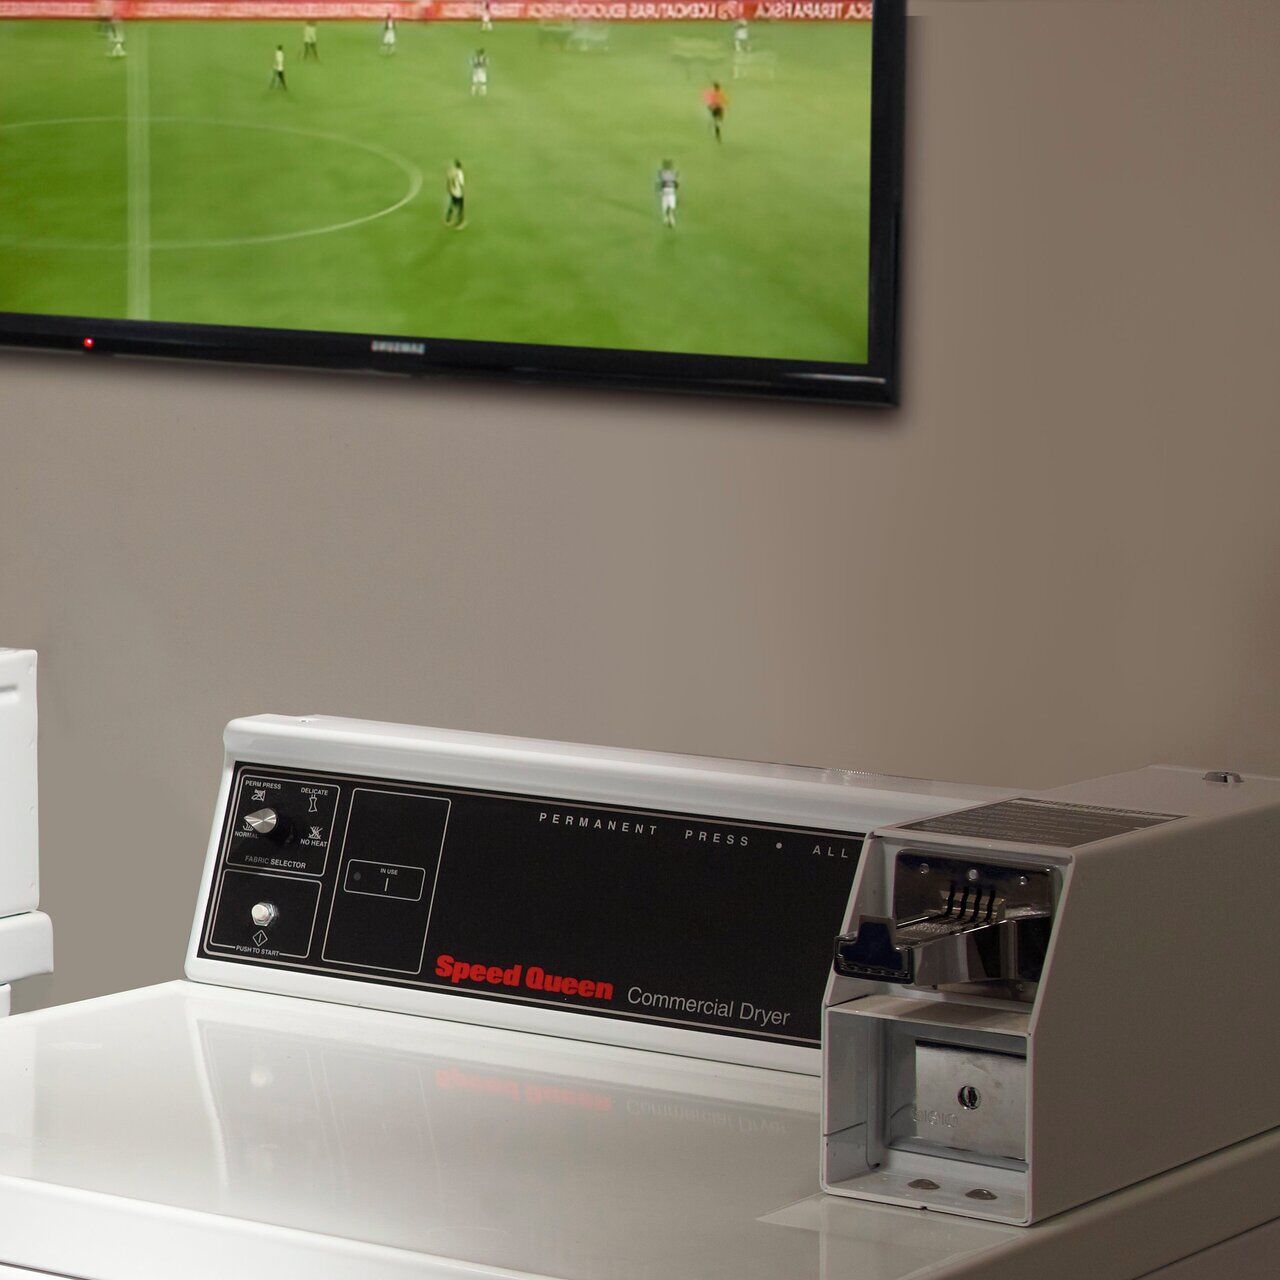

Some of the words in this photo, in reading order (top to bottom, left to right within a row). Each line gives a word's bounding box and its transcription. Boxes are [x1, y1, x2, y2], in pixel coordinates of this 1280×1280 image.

[245, 779, 261, 788] PERM
[262, 781, 282, 790] PRESS
[300, 787, 329, 796] DELICATE
[539, 812, 658, 836] PERMANENT
[685, 829, 749, 846] PRESS
[813, 845, 849, 858] ALL
[300, 838, 309, 846] NO
[310, 839, 328, 847] HEAT
[244, 855, 270, 864] FABRIC
[270, 858, 306, 869] SELECTOR
[236, 944, 252, 953] PUSH
[260, 948, 280, 957] START
[435, 954, 522, 988] Speed
[525, 966, 614, 1000] Queen
[627, 986, 734, 1018] Commercial
[740, 1001, 792, 1028] Dryer
